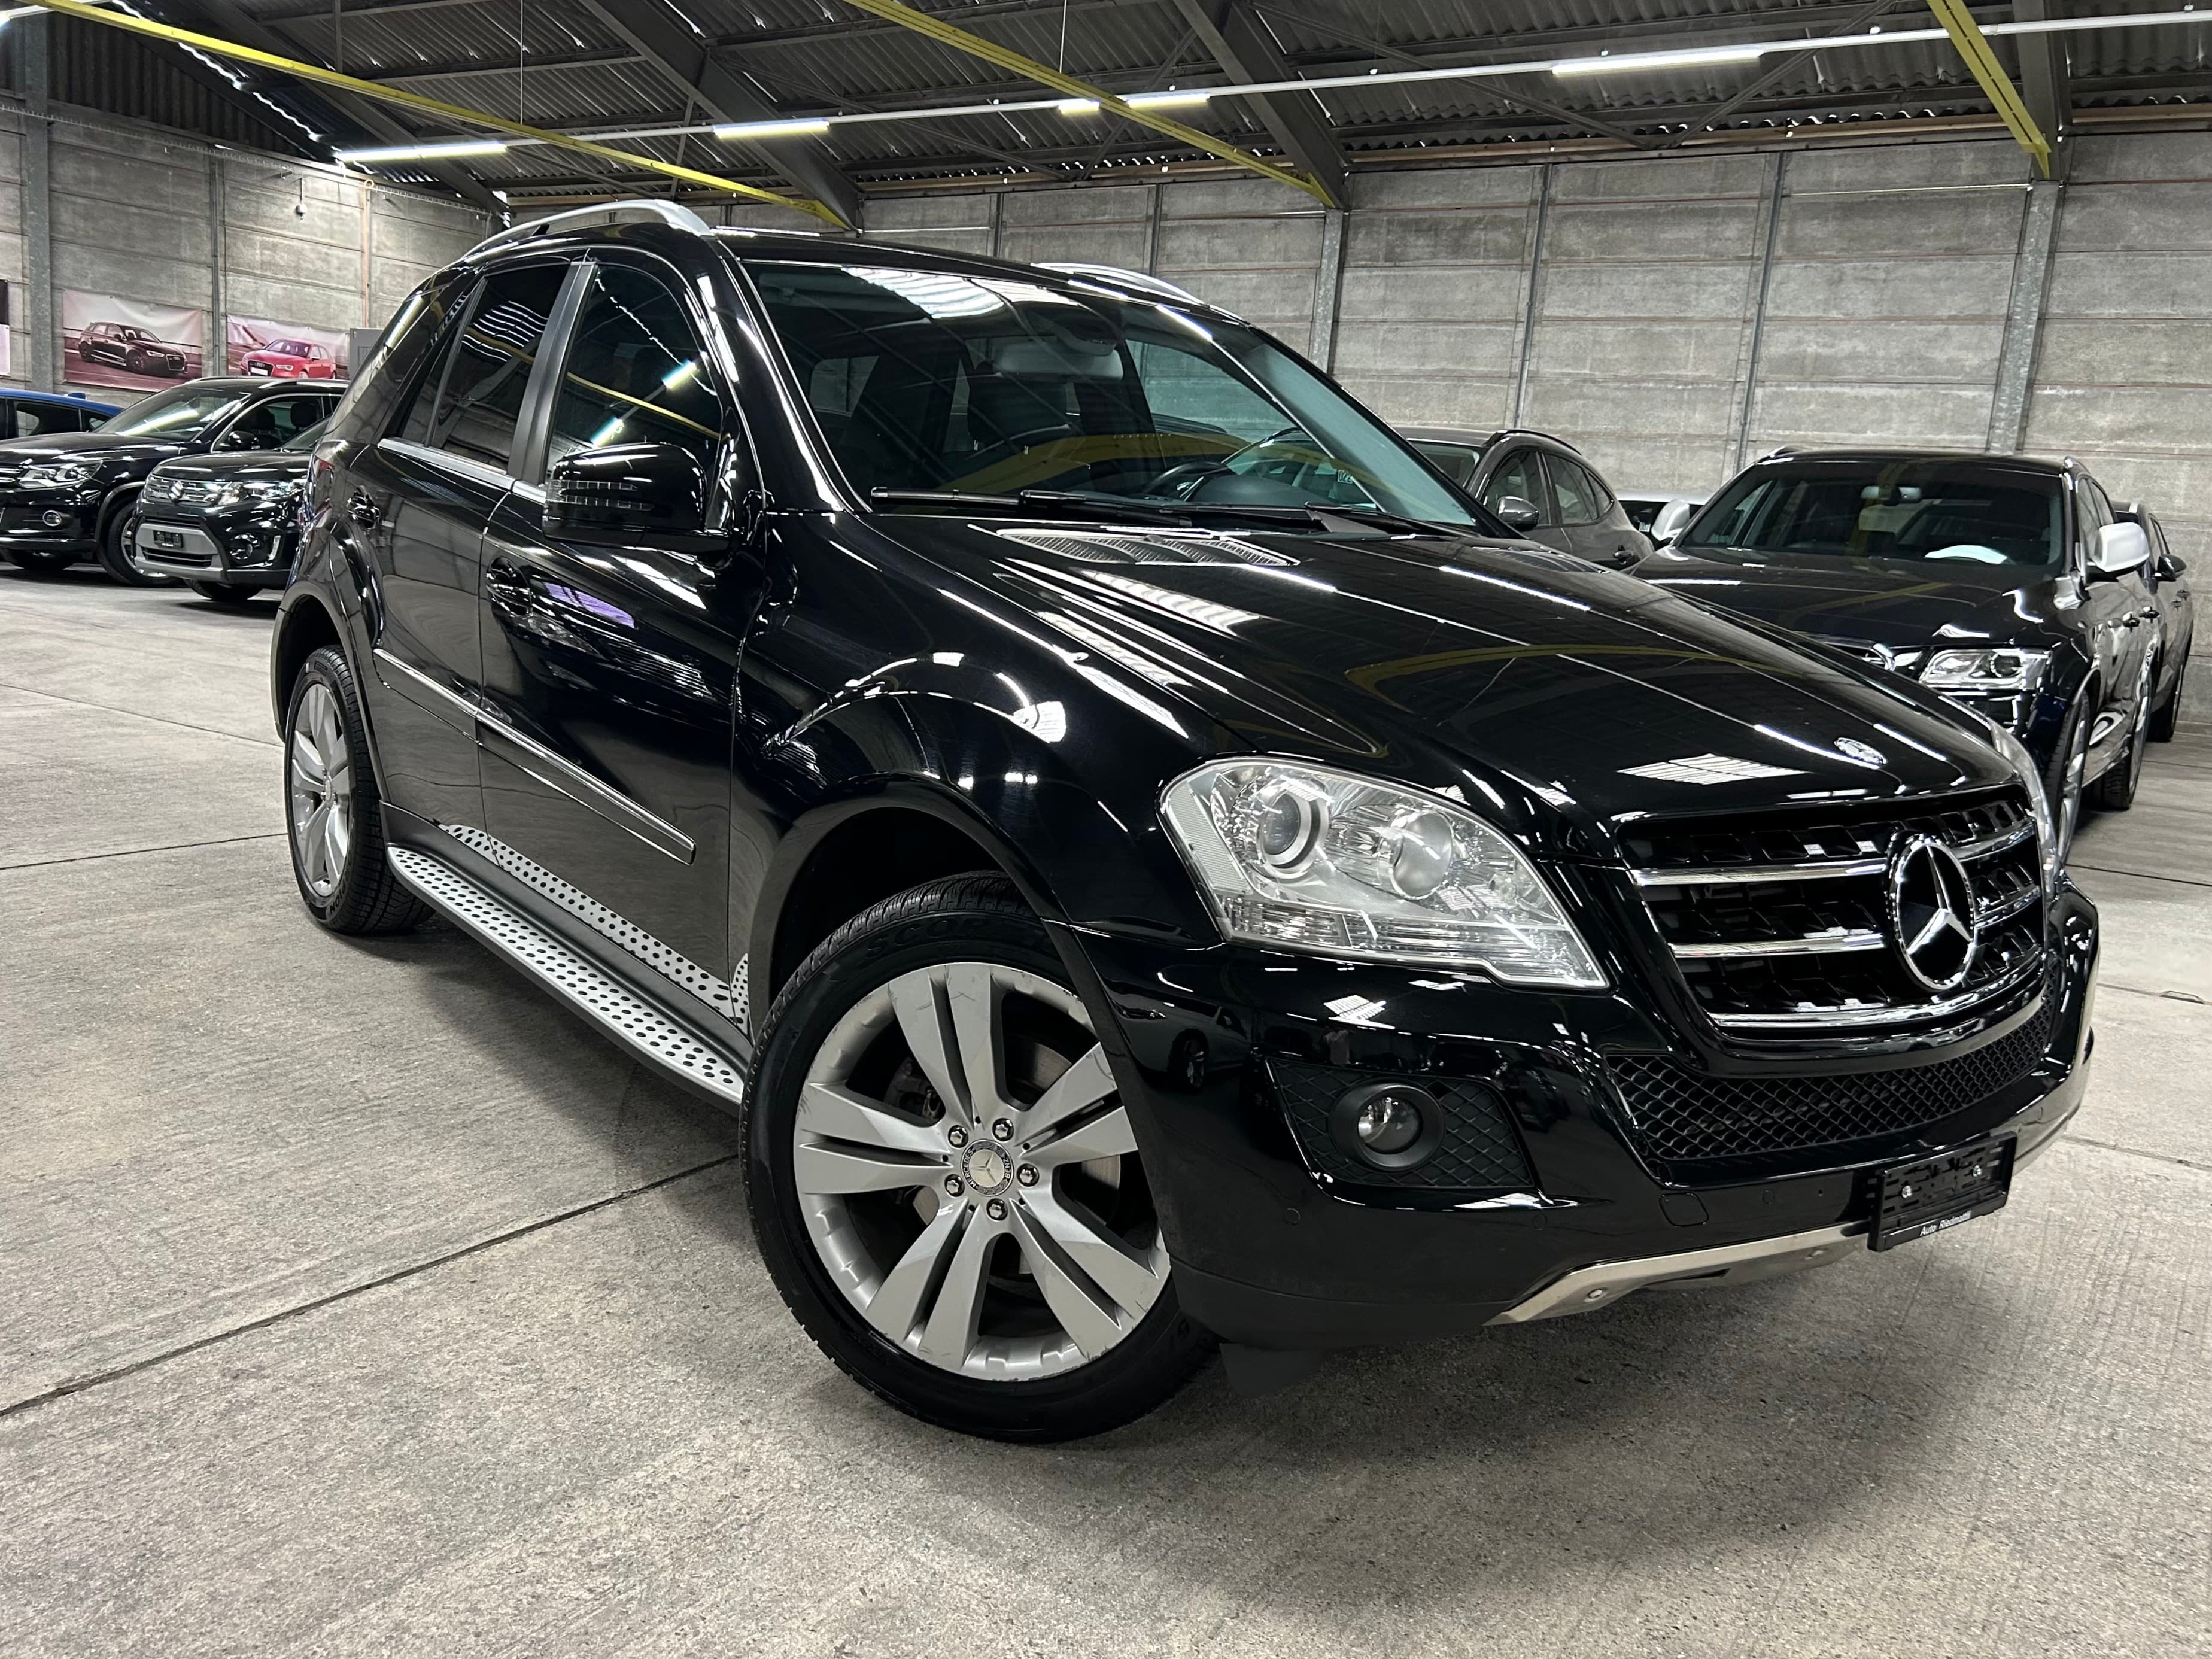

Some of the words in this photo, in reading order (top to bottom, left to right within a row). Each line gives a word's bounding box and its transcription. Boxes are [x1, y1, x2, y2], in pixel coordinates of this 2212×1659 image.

[963, 1148, 977, 1188] MERCEDES
[1003, 1157, 1011, 1179] BENZ
[1919, 1224, 1937, 1236] Auto
